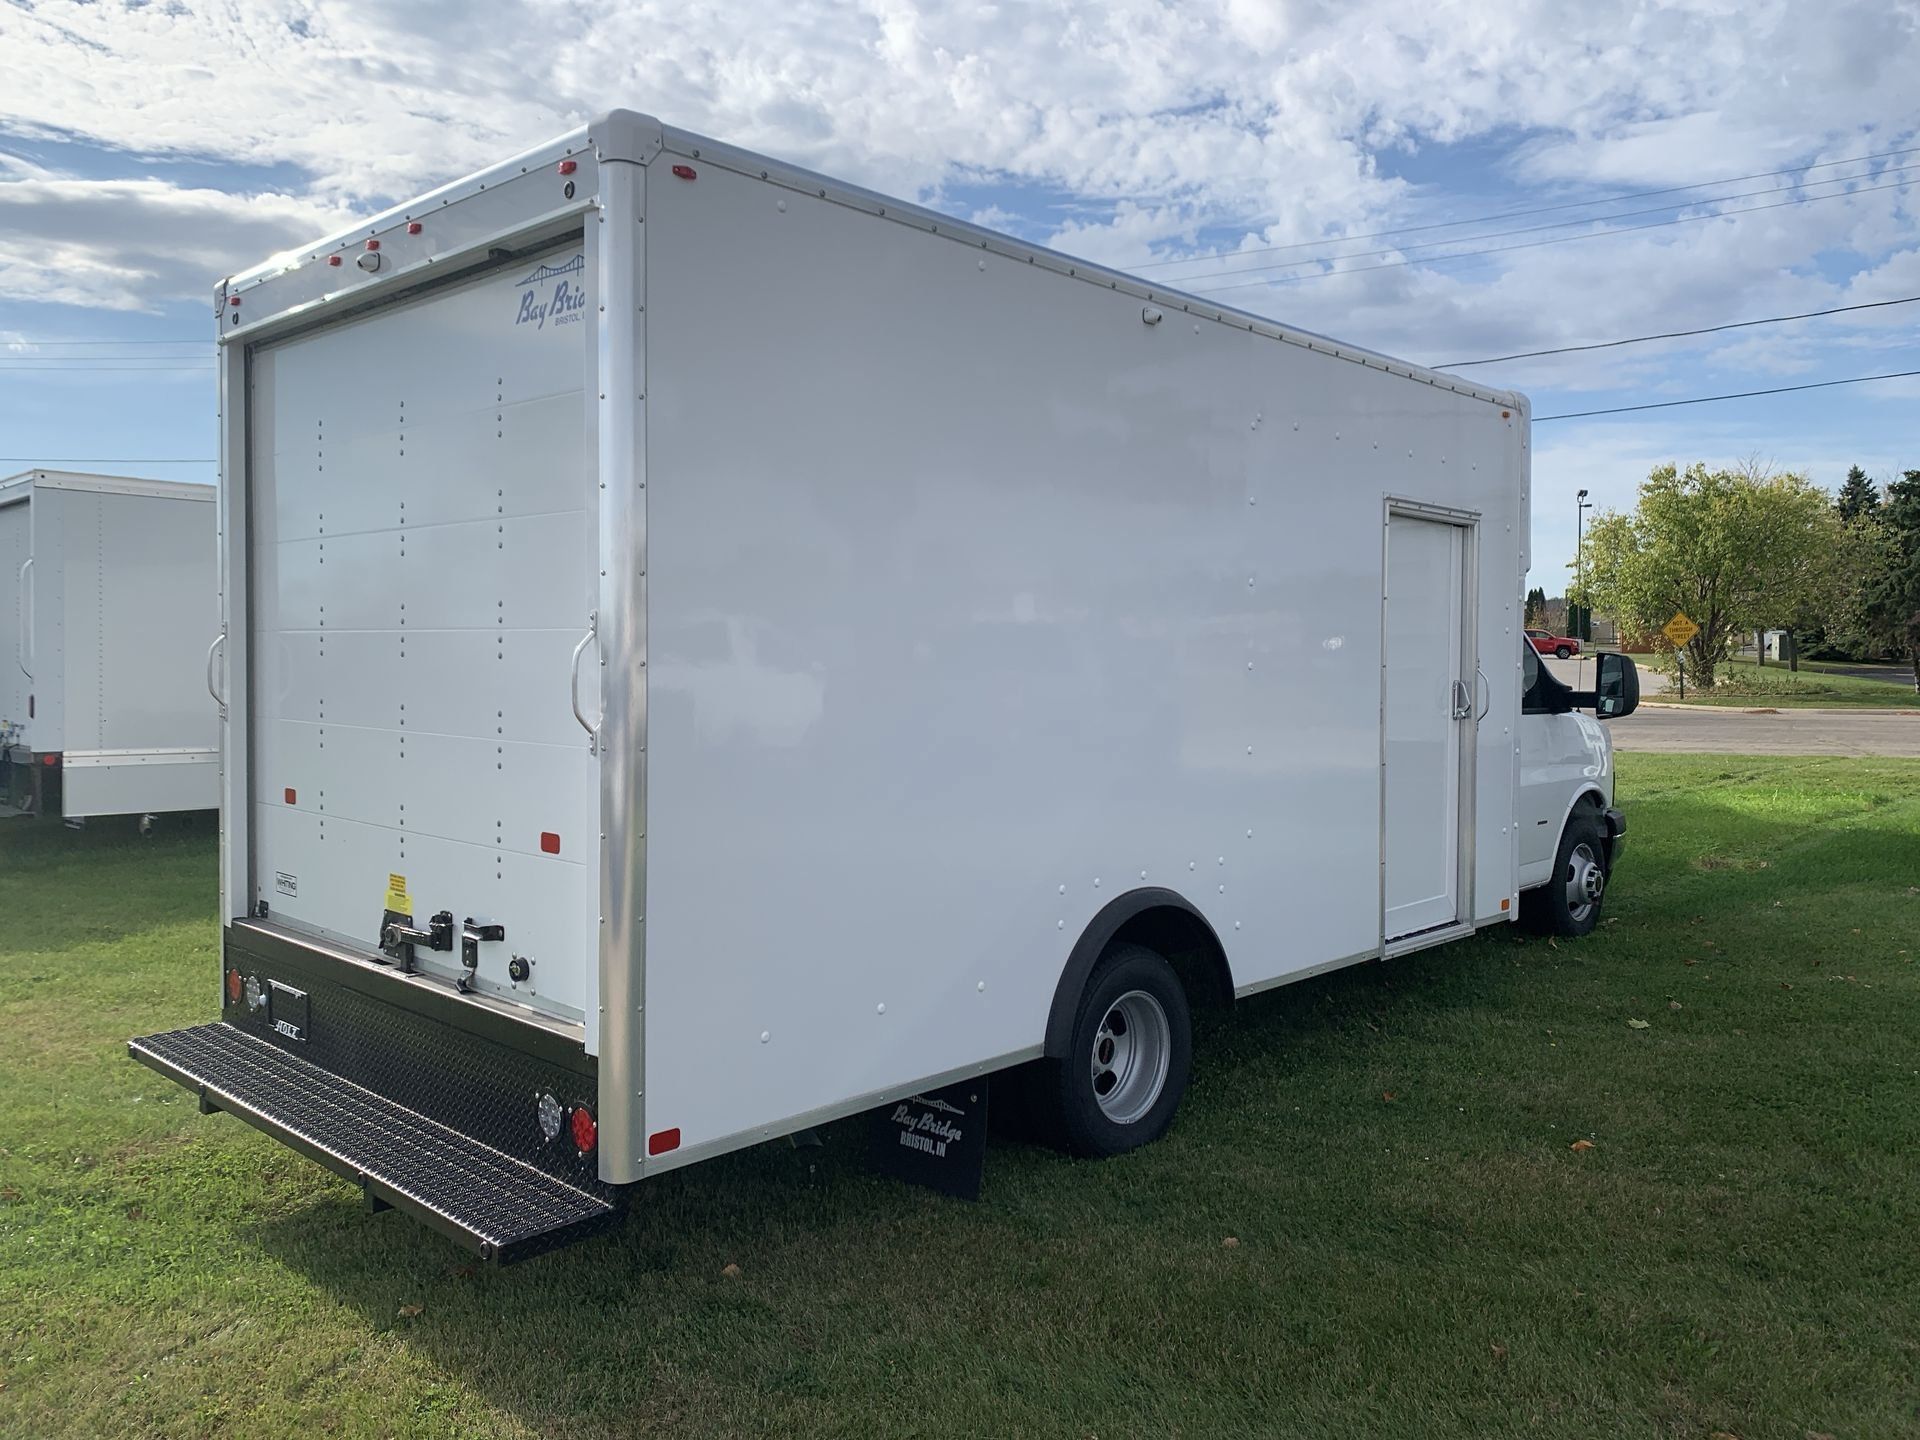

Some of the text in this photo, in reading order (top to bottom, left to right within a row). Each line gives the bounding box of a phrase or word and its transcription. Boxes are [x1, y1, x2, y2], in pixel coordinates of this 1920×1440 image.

[516, 290, 548, 330] Bay
[891, 1104, 962, 1144] Bay Bridge
[900, 1130, 947, 1158] BRISTOL, IN
